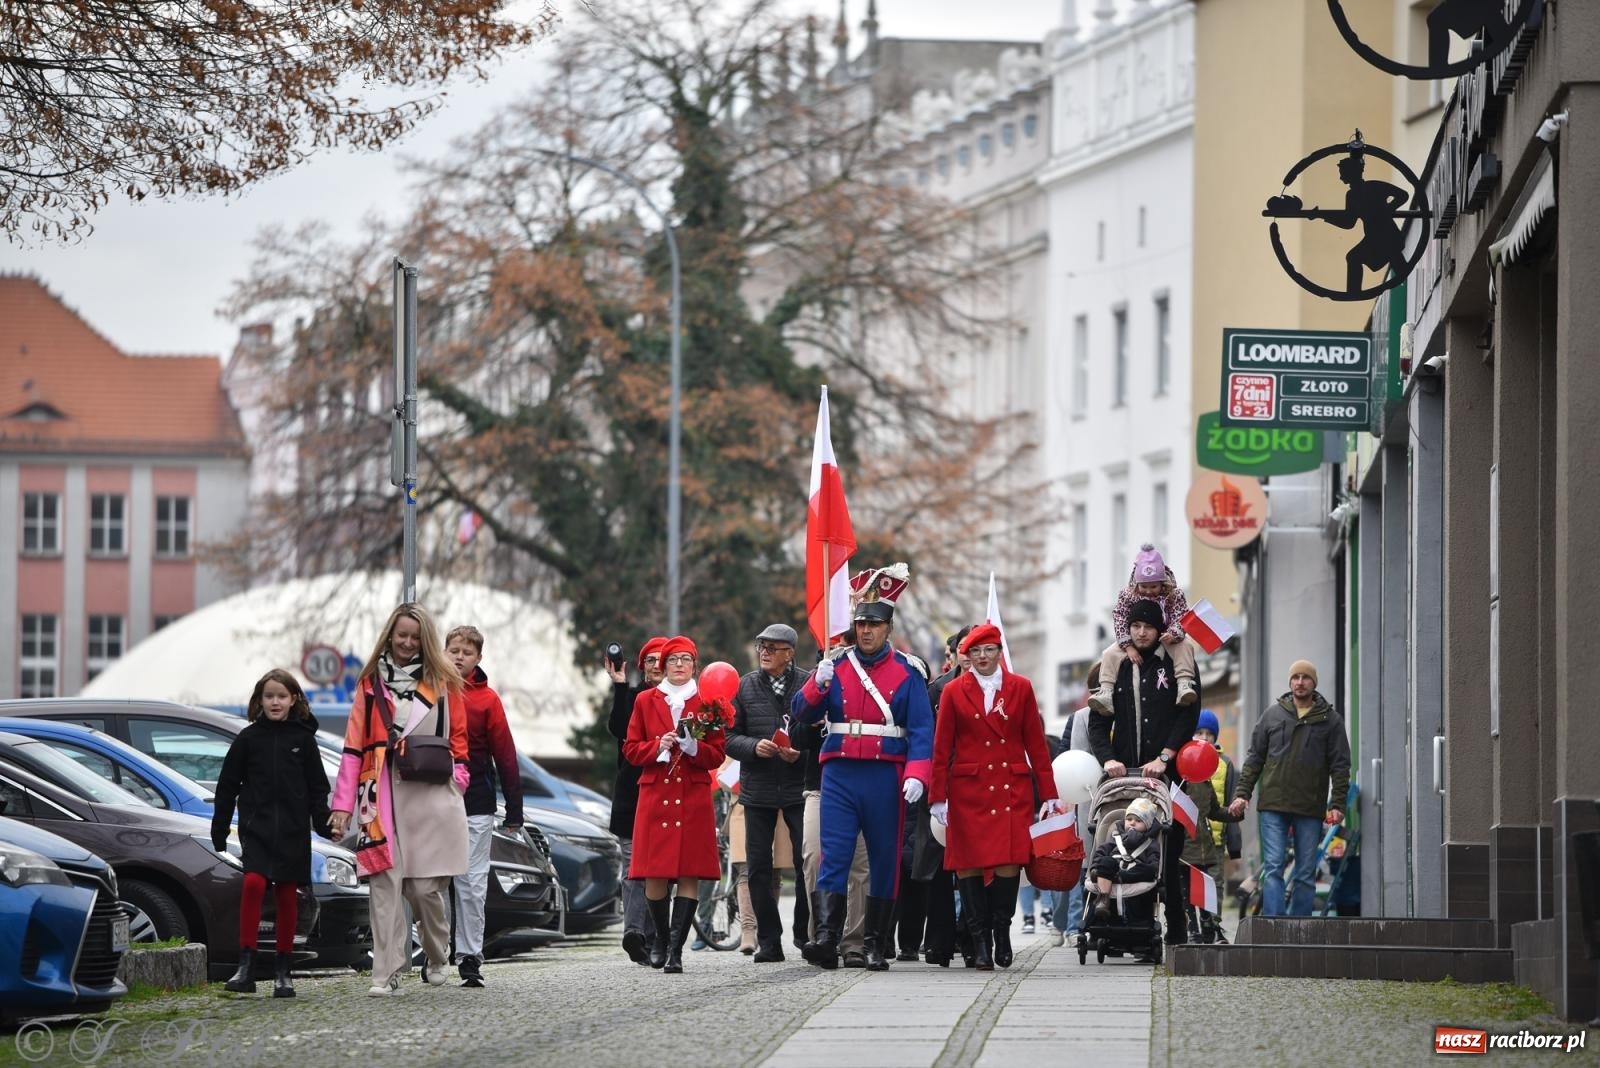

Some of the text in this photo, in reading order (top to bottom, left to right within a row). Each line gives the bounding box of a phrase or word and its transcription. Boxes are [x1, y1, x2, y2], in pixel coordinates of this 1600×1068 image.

[1238, 343, 1361, 365] LOOMBARD
[1300, 379, 1349, 393] ZŁOTO
[1253, 406, 1269, 417] 21
[1291, 404, 1357, 418] SREBRO
[309, 654, 339, 675] 30
